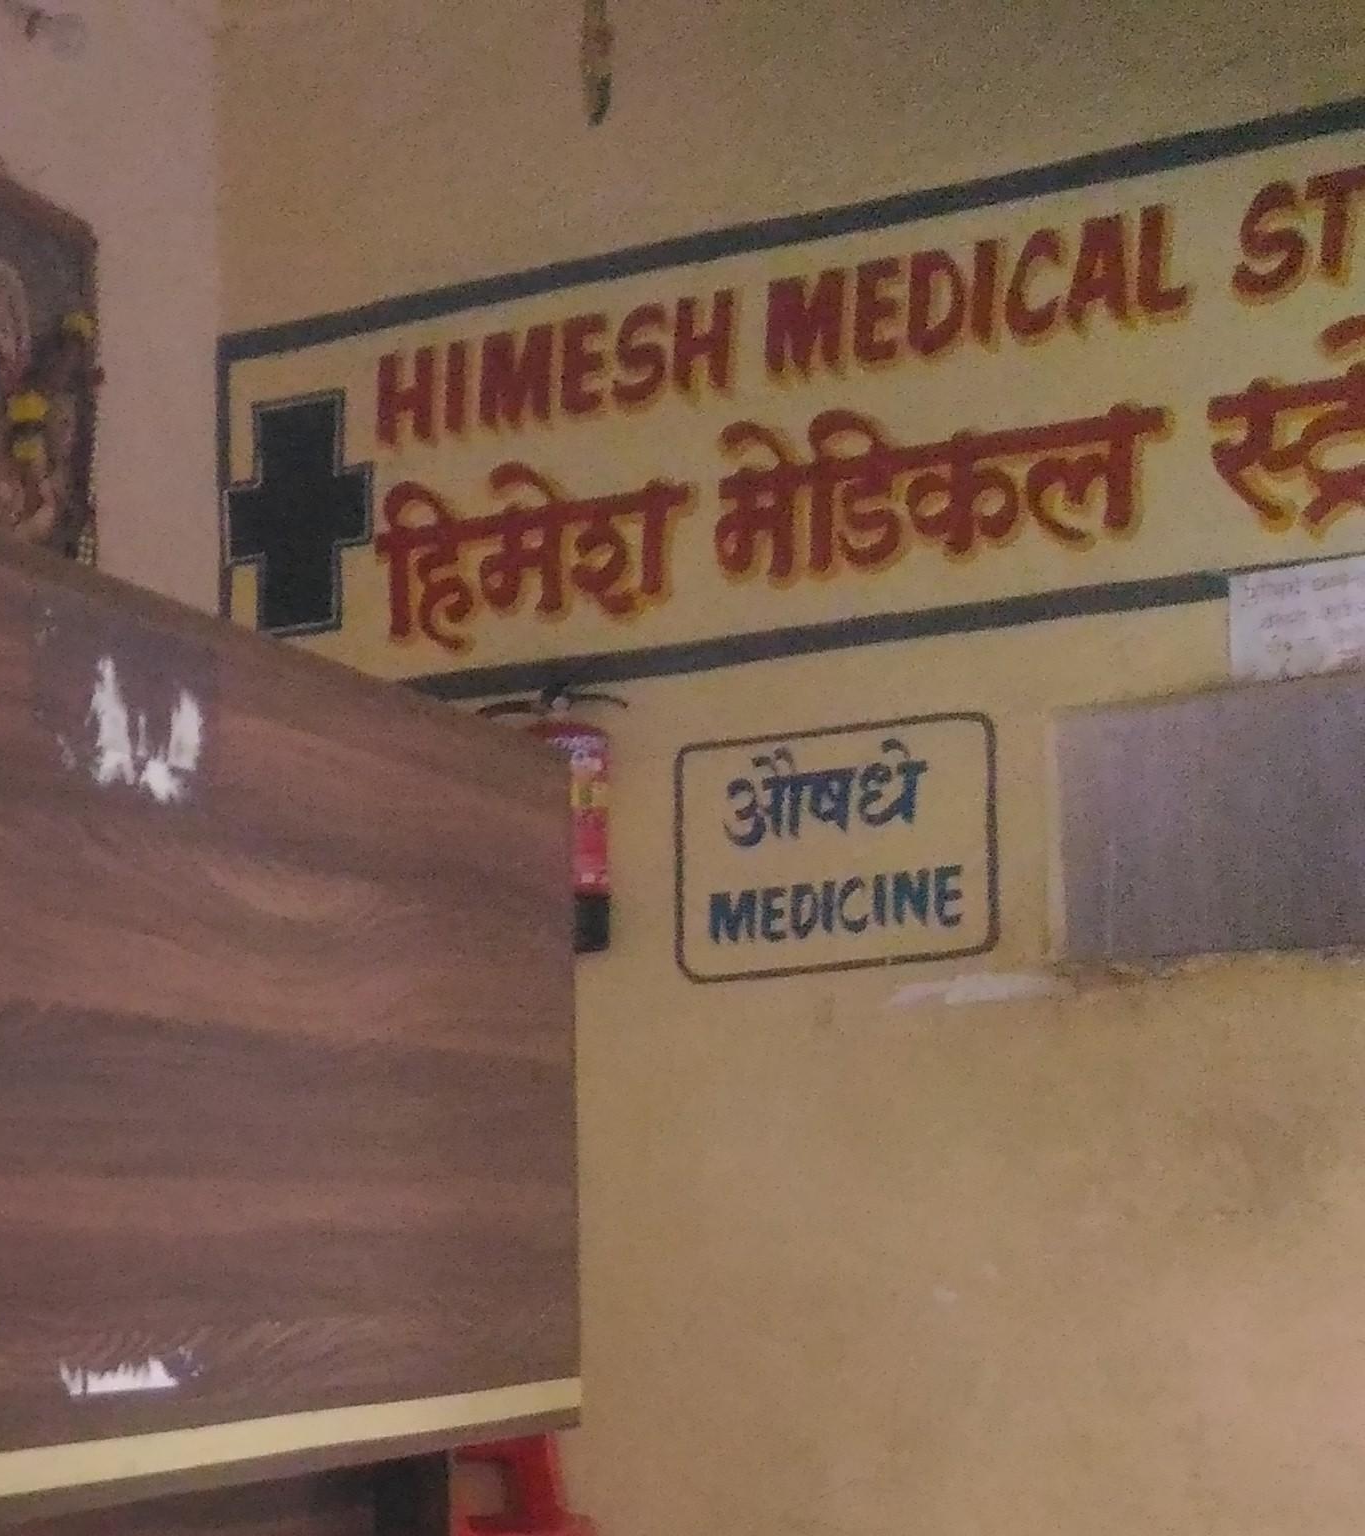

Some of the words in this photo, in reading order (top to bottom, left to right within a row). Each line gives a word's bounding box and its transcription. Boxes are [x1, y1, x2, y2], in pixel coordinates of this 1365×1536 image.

[375, 289, 736, 446] HIMESH
[765, 204, 1189, 375] MEDICAL
[1232, 165, 1365, 296] ST
[375, 461, 695, 651] हिमेश
[715, 405, 1173, 580] मेडिकल
[709, 864, 963, 944] MEDICINE
